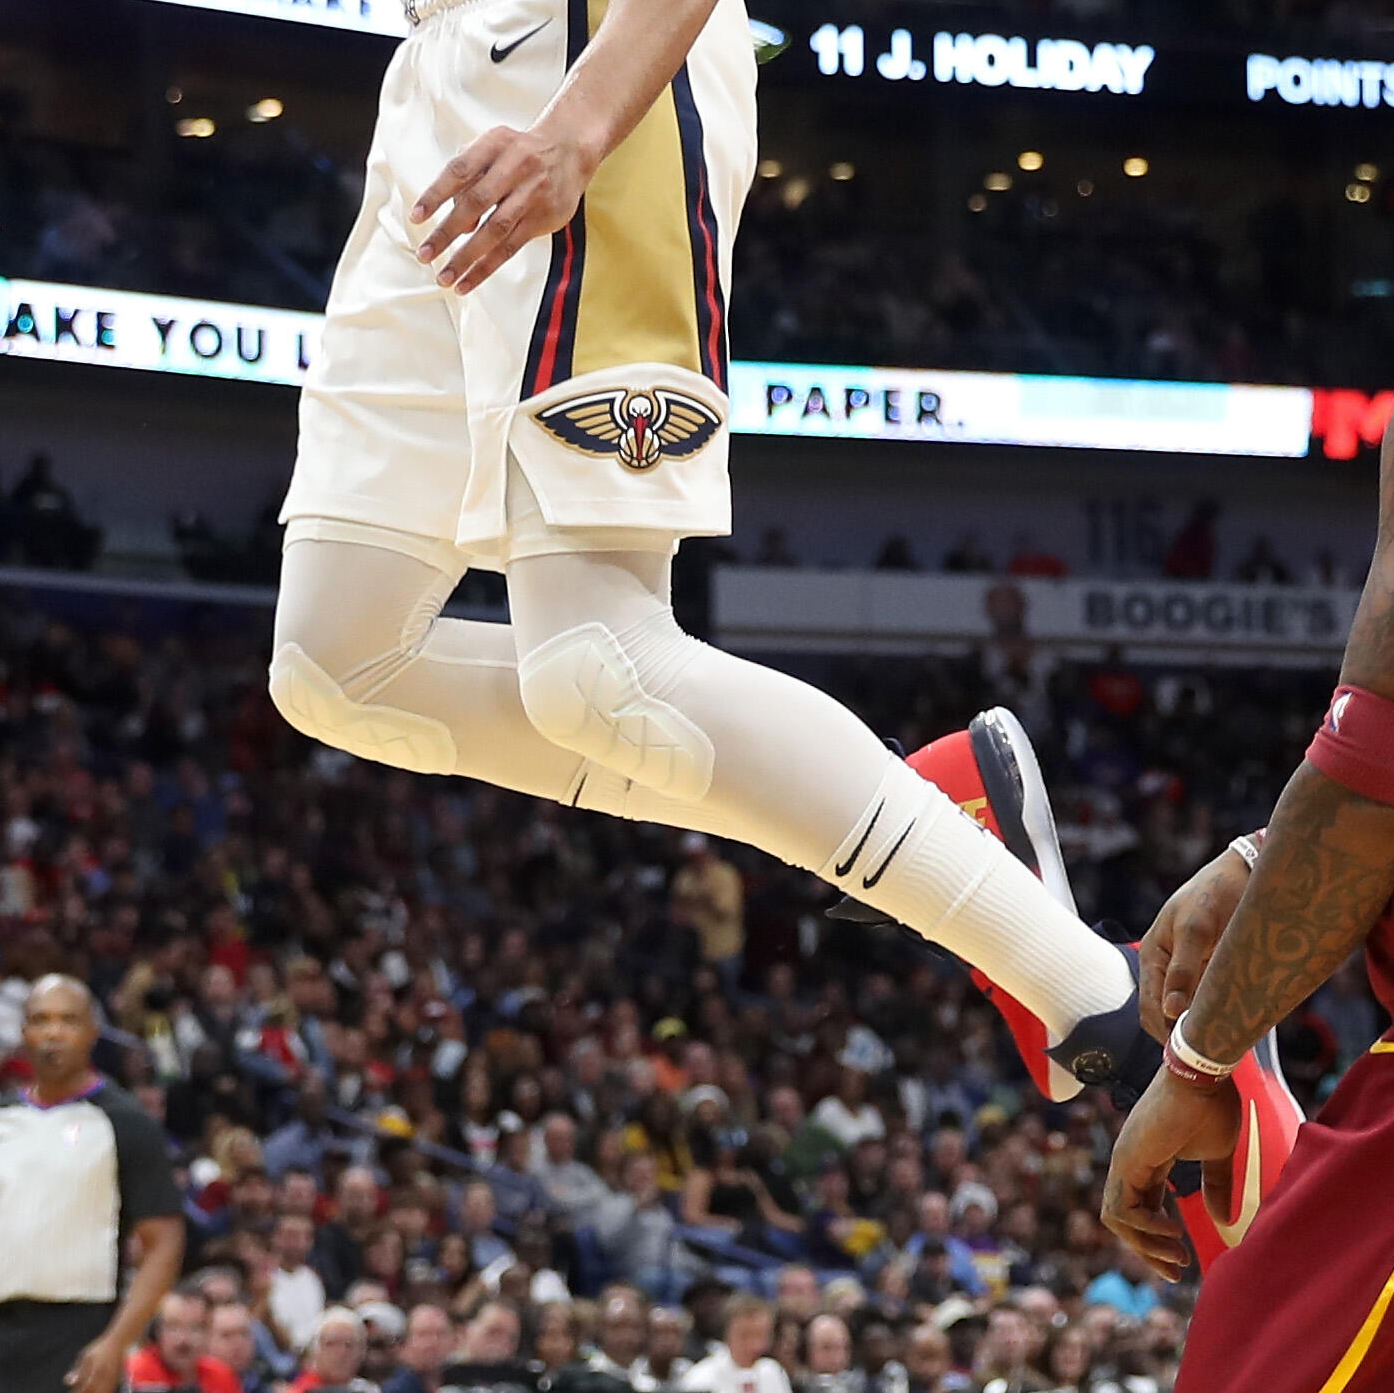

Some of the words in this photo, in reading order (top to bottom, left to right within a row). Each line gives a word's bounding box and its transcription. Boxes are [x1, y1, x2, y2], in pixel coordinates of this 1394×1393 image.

[810, 23, 865, 77] 11
[876, 28, 927, 81] J.
[933, 32, 1156, 96] HOLIDAY
[150, 315, 265, 364] YOU
[765, 383, 966, 429] PAPER.
[1084, 591, 1338, 636] BOOGIE'S
